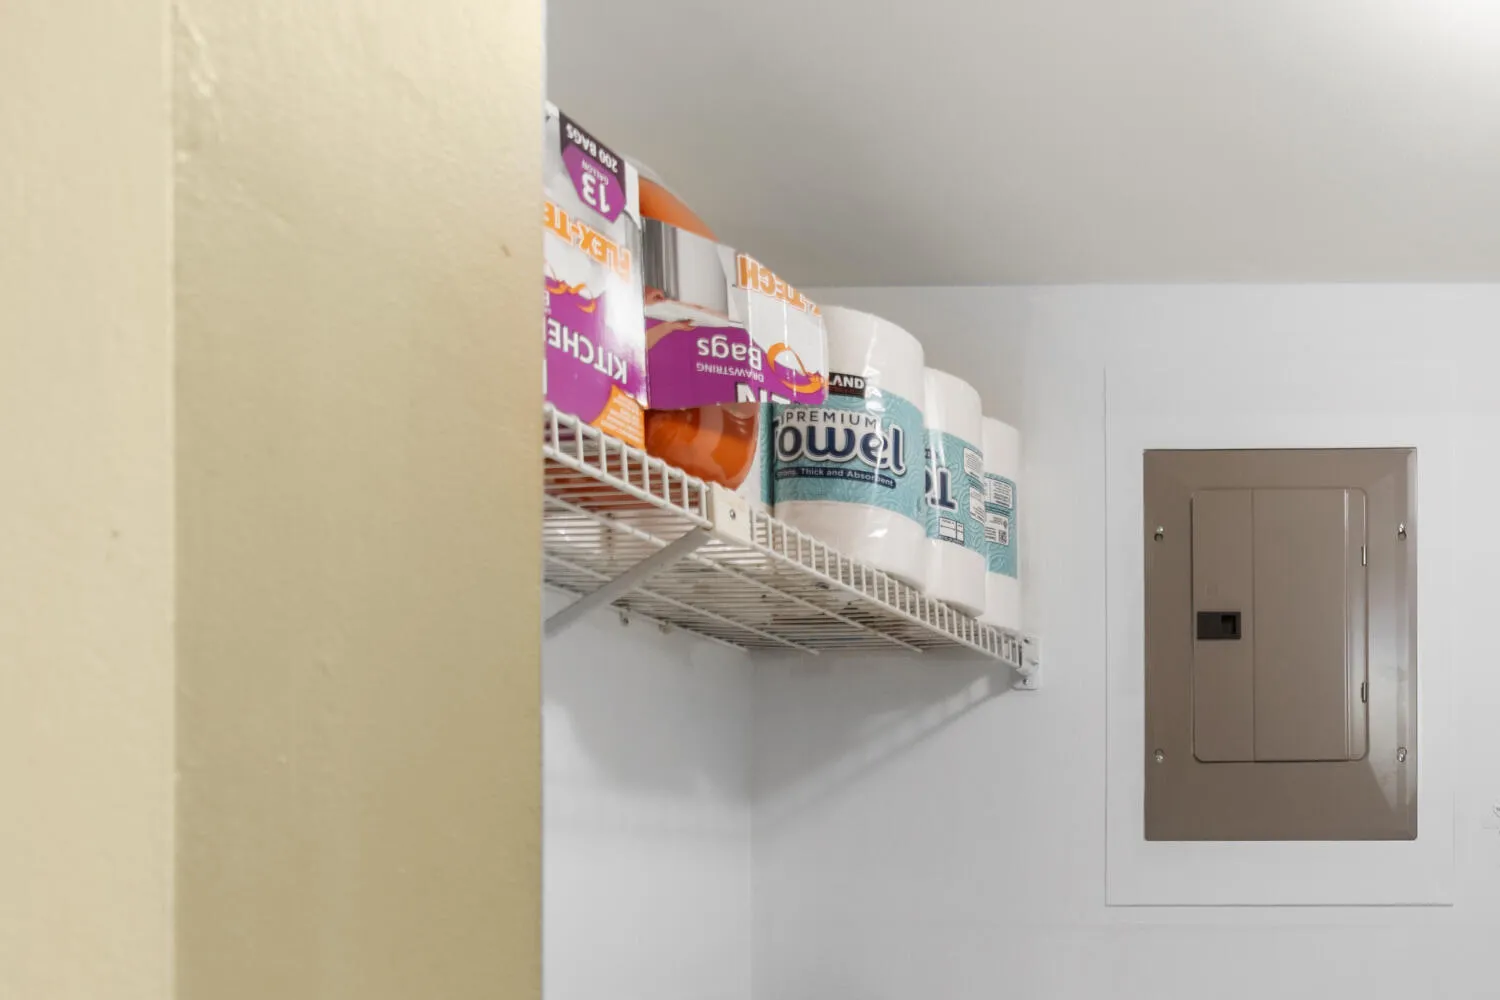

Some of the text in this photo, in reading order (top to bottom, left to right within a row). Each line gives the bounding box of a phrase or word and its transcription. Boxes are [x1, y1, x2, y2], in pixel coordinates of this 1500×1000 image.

[565, 123, 618, 173] 200 BAGS
[581, 171, 610, 214] 13
[544, 201, 631, 283] FLEX-TE
[547, 316, 629, 385] KITCHE
[697, 334, 762, 371] Bags
[696, 362, 765, 383] DRAWSTRING
[786, 411, 877, 429] PREMIUM
[772, 419, 904, 472] owel
[801, 468, 825, 476] Thick
[827, 469, 844, 477] and
